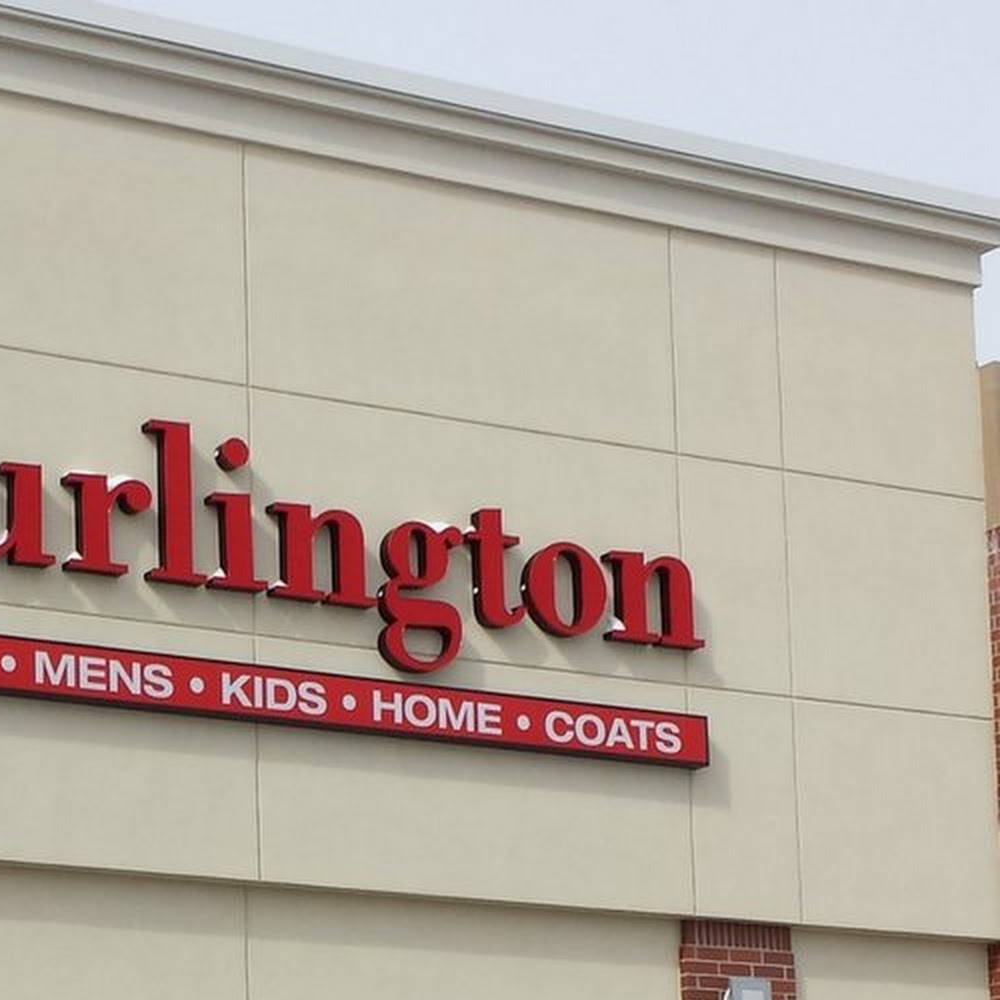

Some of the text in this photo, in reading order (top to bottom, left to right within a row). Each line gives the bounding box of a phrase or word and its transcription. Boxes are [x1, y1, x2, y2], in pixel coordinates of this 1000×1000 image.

[34, 650, 175, 699] MENS
[220, 671, 328, 716] KIDS
[372, 689, 503, 736] HOME
[544, 709, 683, 755] COATS
